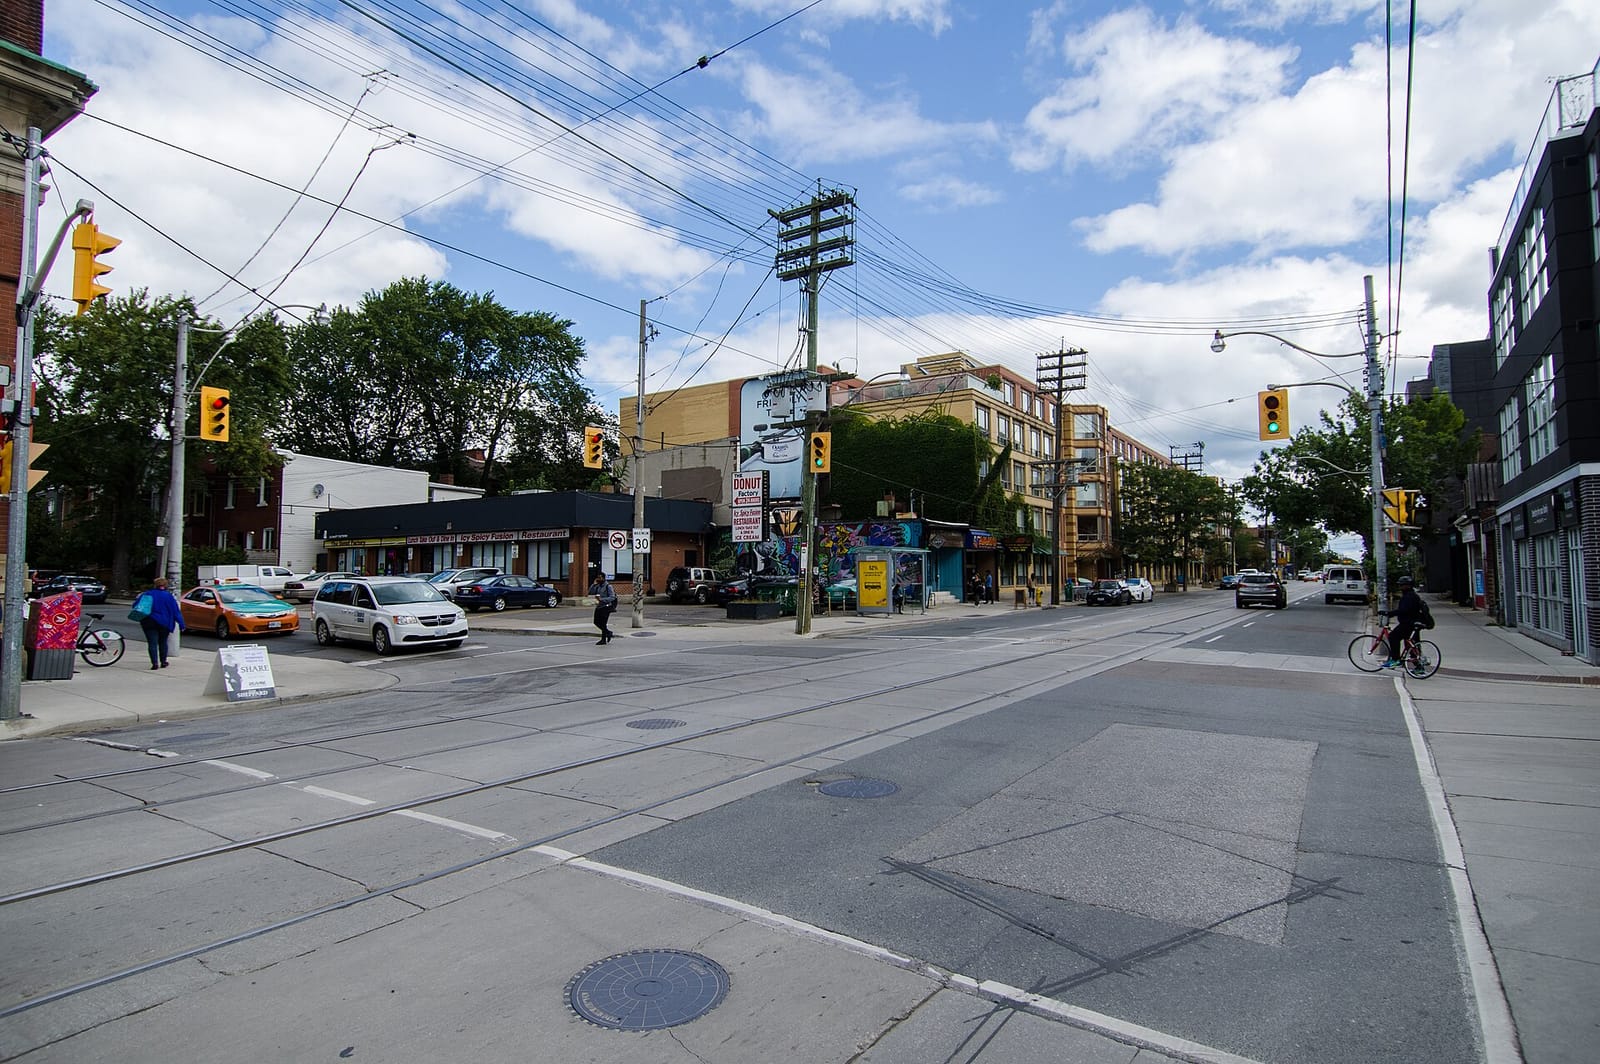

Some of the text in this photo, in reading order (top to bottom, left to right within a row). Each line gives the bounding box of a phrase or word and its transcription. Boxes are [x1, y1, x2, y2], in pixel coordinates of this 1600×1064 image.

[733, 477, 761, 490] DONUT
[733, 517, 761, 525] RESTAURANT
[461, 532, 514, 542] Icy Spicy Fusion
[521, 529, 567, 539] Restaurant
[635, 538, 649, 550] 30
[240, 665, 270, 673] SHARE
